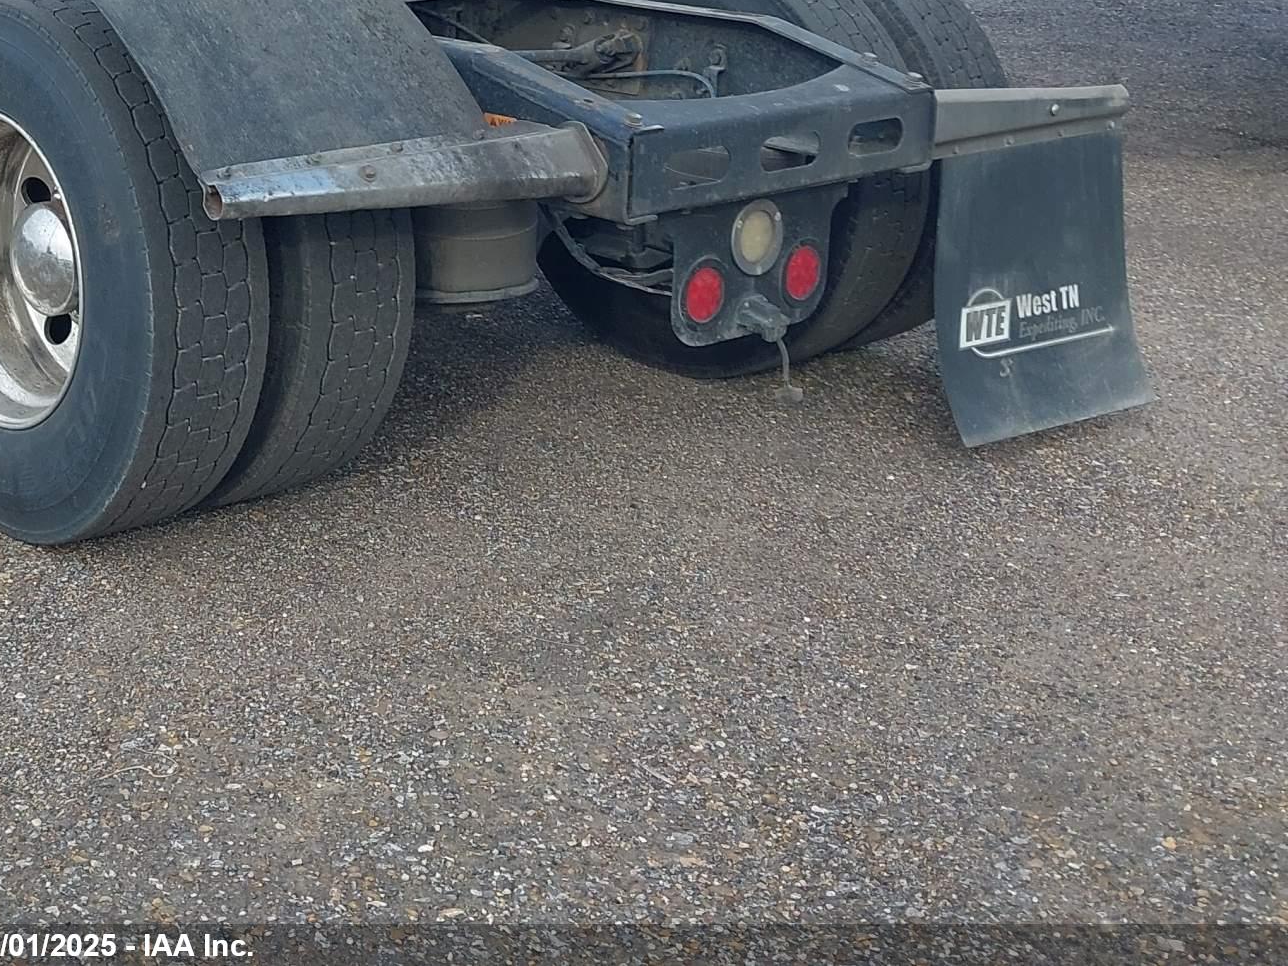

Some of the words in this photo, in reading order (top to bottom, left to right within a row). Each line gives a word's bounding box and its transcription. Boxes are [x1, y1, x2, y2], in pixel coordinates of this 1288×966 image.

[1016, 290, 1058, 318] West
[1059, 284, 1080, 309] TN
[966, 305, 1006, 342] WTE
